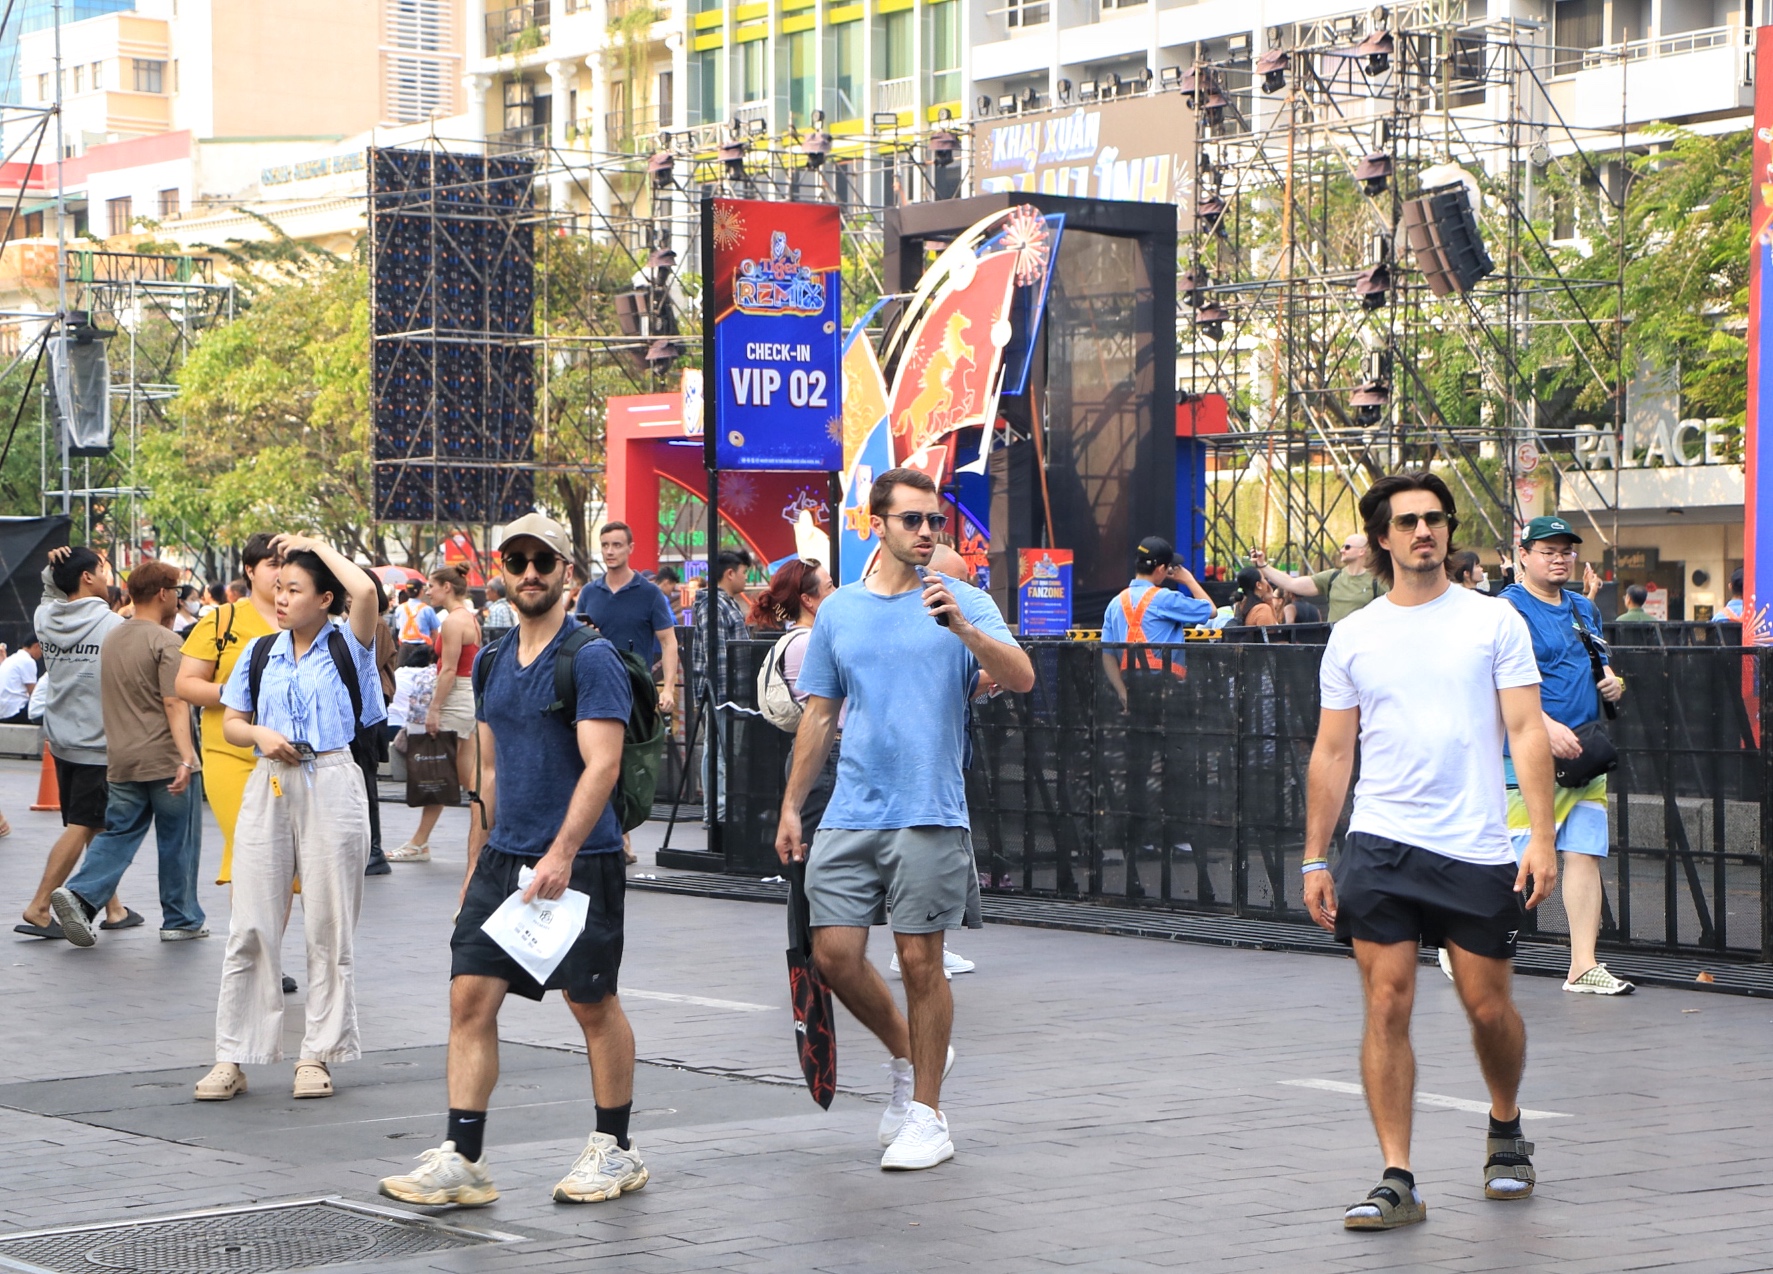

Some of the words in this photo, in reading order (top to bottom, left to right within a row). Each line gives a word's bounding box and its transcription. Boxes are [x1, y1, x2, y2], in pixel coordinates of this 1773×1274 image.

[760, 257, 800, 280] Tiger
[737, 281, 825, 310] REMIX
[746, 342, 811, 362] CHECK-IN
[731, 367, 782, 406] VIP
[789, 369, 828, 407] 02
[1574, 417, 1729, 470] PALACE
[844, 503, 871, 541] Tig
[1027, 587, 1065, 599] FANZONE
